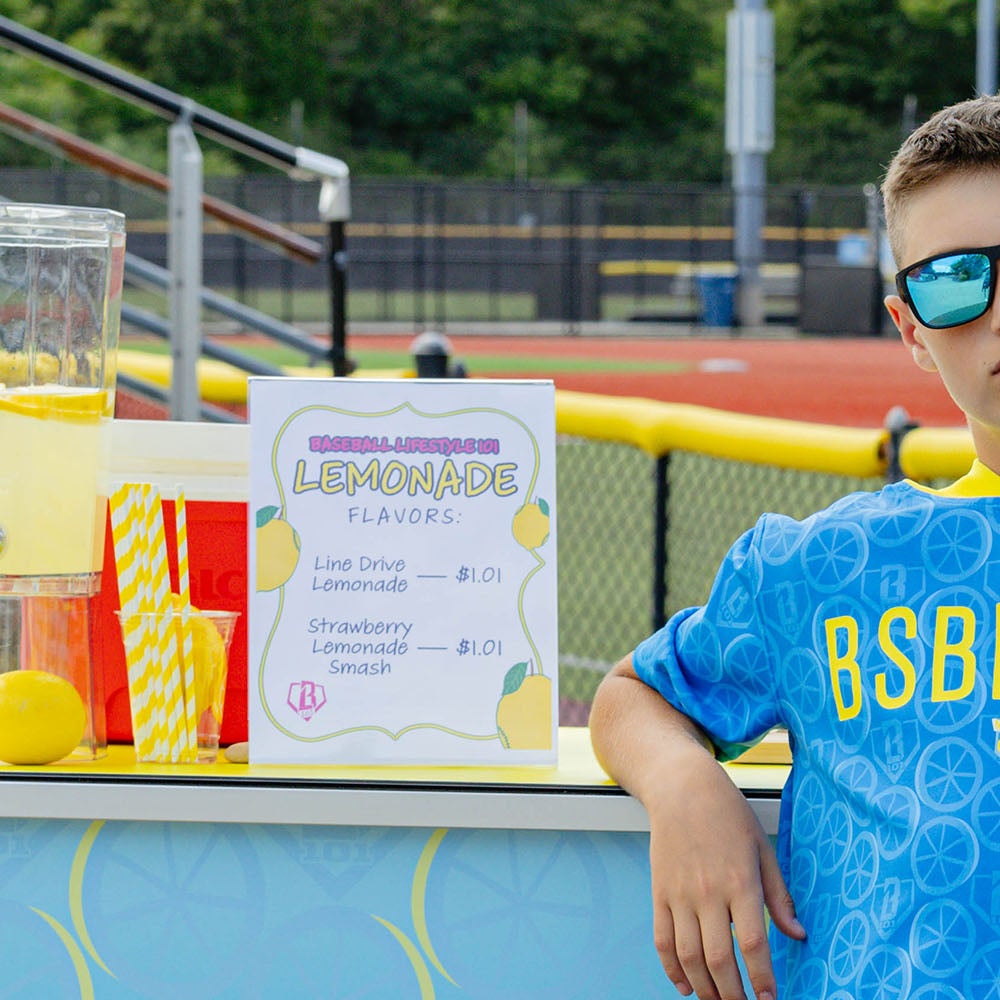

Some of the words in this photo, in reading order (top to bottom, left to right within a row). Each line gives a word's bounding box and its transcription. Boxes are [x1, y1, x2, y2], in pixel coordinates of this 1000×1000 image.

[309, 435, 393, 453] BASEBALL
[393, 437, 477, 456] LIFESTYLE
[293, 458, 518, 500] LEMONADE
[348, 506, 462, 526] FLAVORS:
[314, 555, 352, 572] Line
[360, 555, 406, 572] Drive
[312, 575, 408, 593] Lemonade
[455, 565, 502, 584] $1.01
[307, 616, 413, 640] Strawberry
[312, 637, 409, 656] Lemonade
[456, 637, 502, 657] $1.01
[328, 658, 391, 675] Smash
